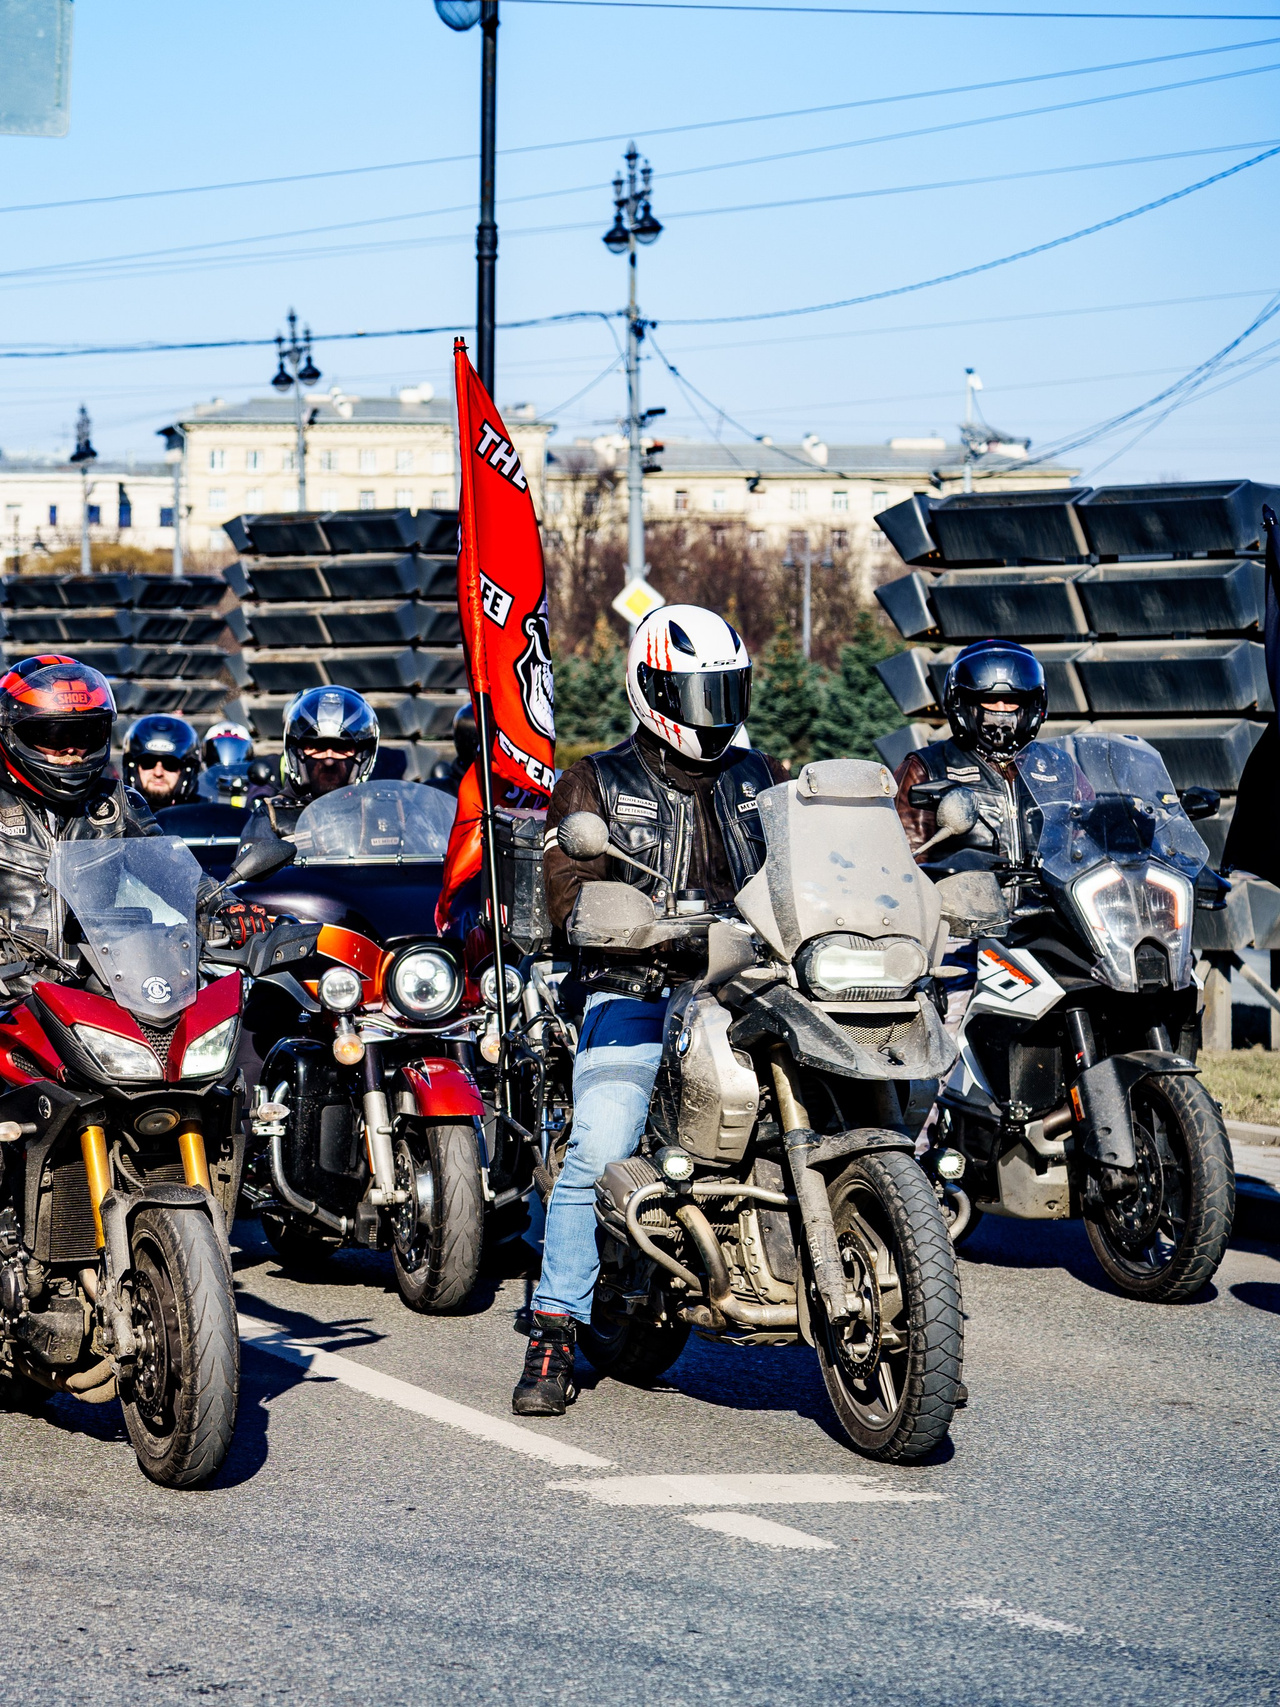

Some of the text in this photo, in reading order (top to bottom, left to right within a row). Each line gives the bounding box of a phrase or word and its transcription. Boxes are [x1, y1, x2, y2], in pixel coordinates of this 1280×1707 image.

[477, 422, 527, 490] THE
[701, 659, 736, 668] LS2
[57, 692, 88, 704] SHOEI
[498, 730, 556, 794] ETER
[982, 948, 1034, 986] SUPER
